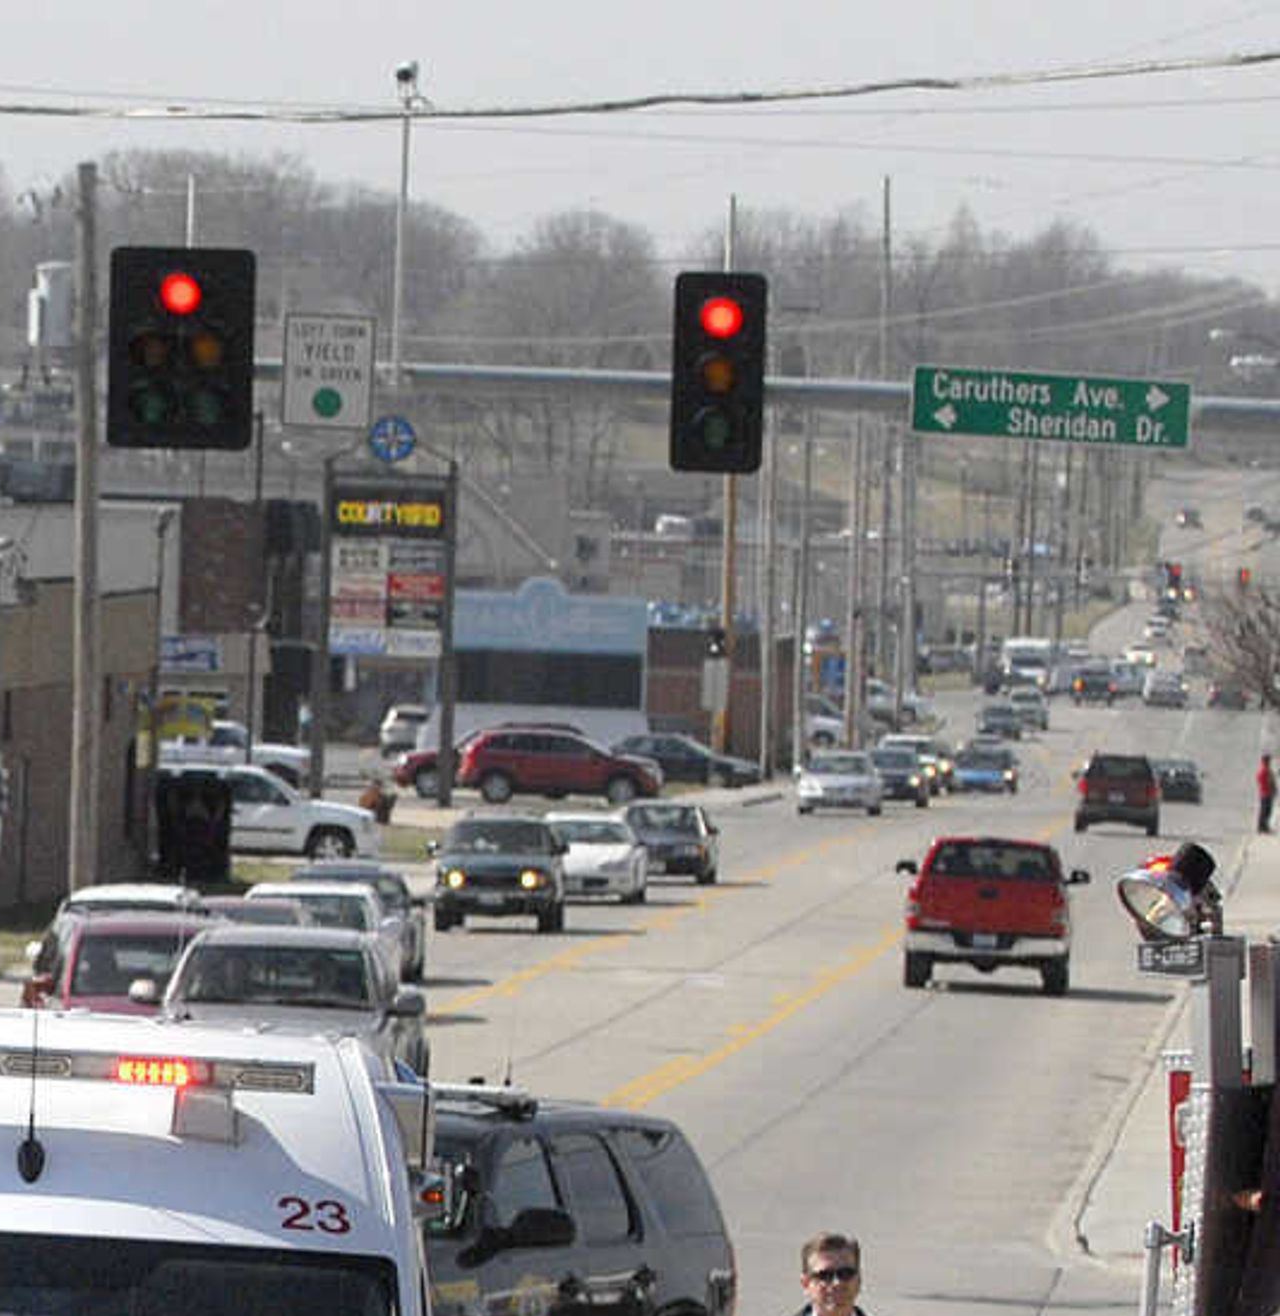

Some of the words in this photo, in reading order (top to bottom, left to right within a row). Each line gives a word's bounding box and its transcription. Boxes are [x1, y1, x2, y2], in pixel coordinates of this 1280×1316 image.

[302, 342, 356, 361] YIELD
[932, 371, 1052, 405] Caruthers
[1072, 380, 1125, 410] Ave.
[1006, 406, 1116, 440] Sheridan
[1136, 415, 1169, 444] Dr.
[278, 1196, 351, 1234] 23
